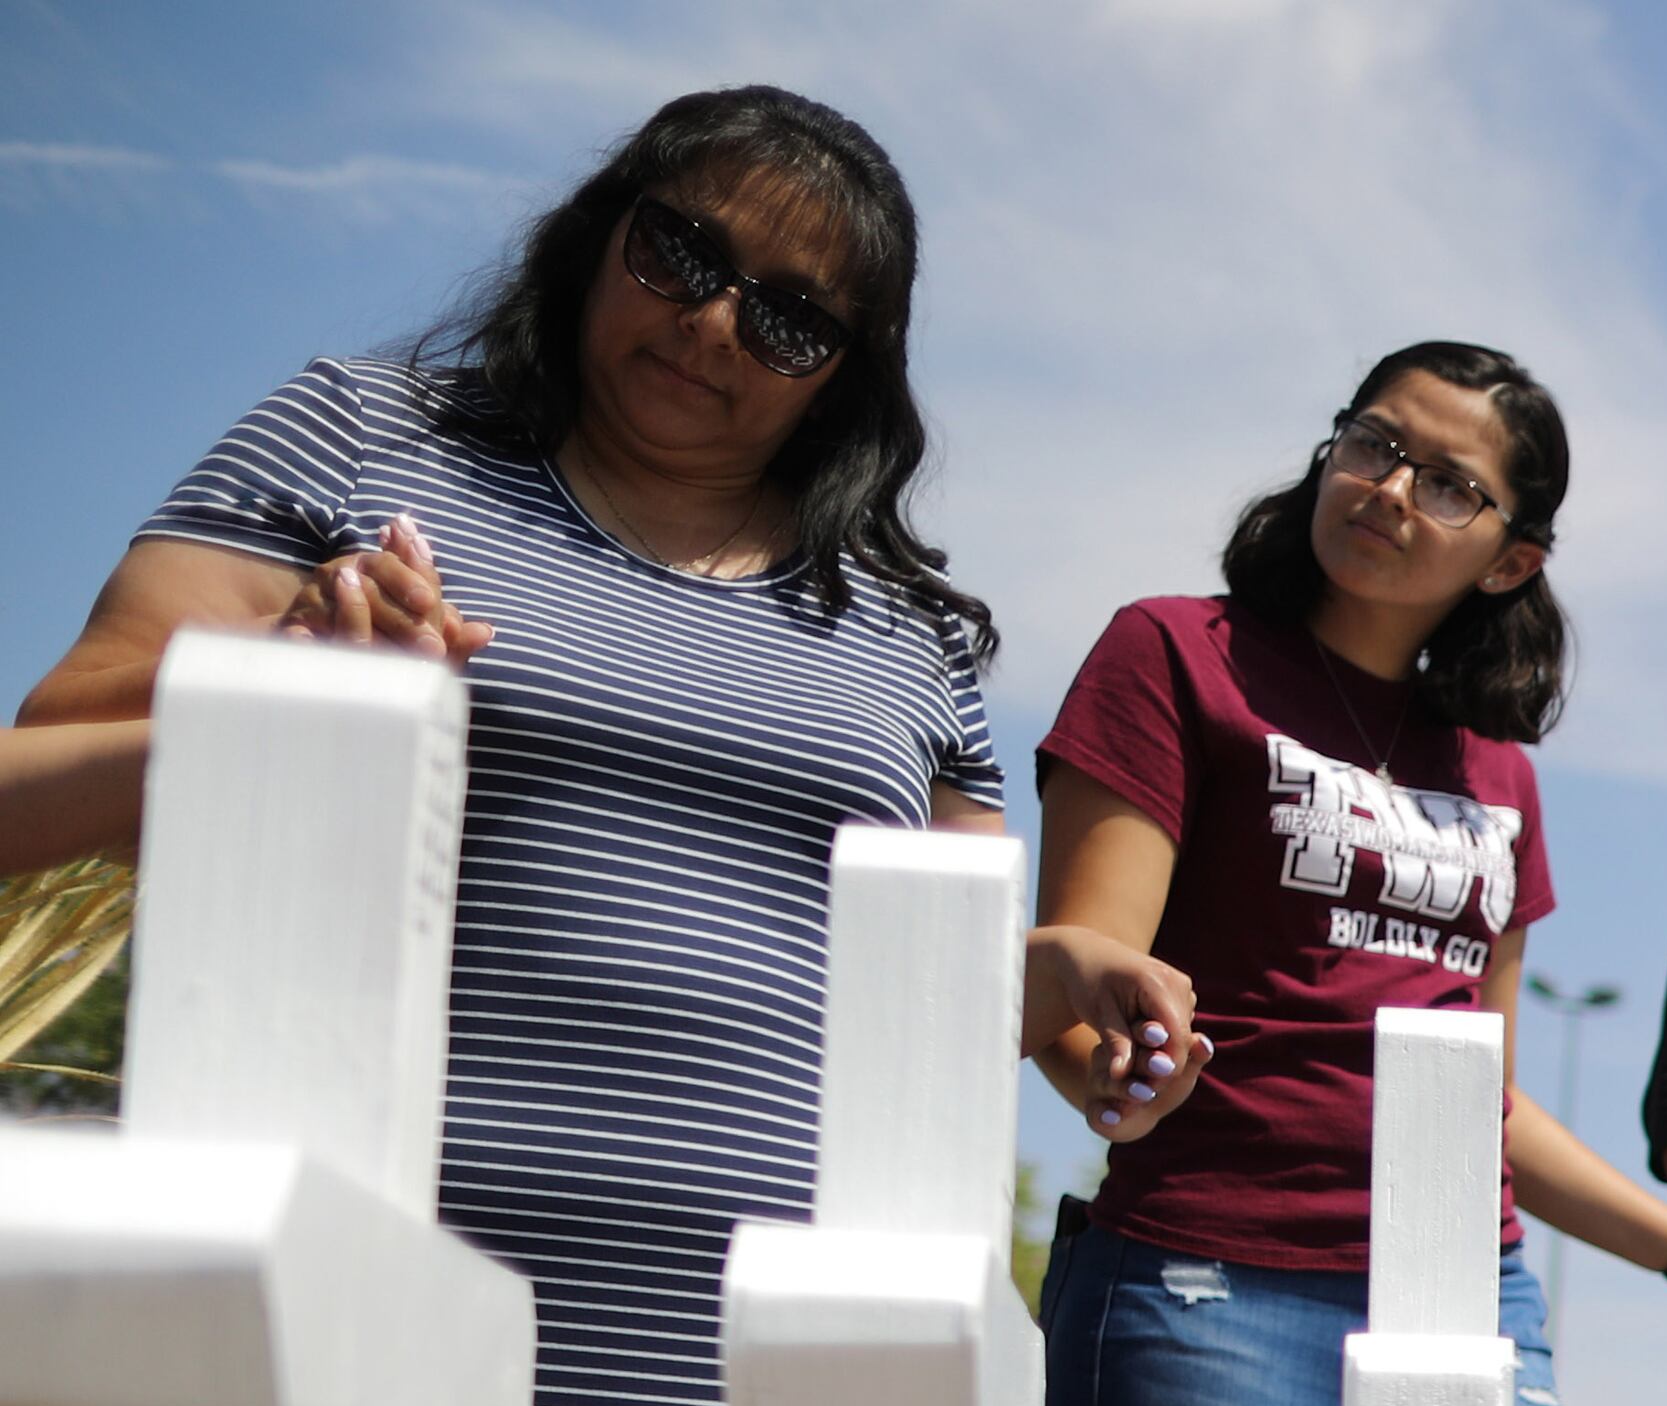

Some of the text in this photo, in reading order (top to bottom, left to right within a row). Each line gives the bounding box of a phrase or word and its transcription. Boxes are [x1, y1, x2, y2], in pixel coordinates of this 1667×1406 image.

[1271, 804, 1354, 839] TEXAS
[1329, 908, 1488, 977] BOLDLY GO
